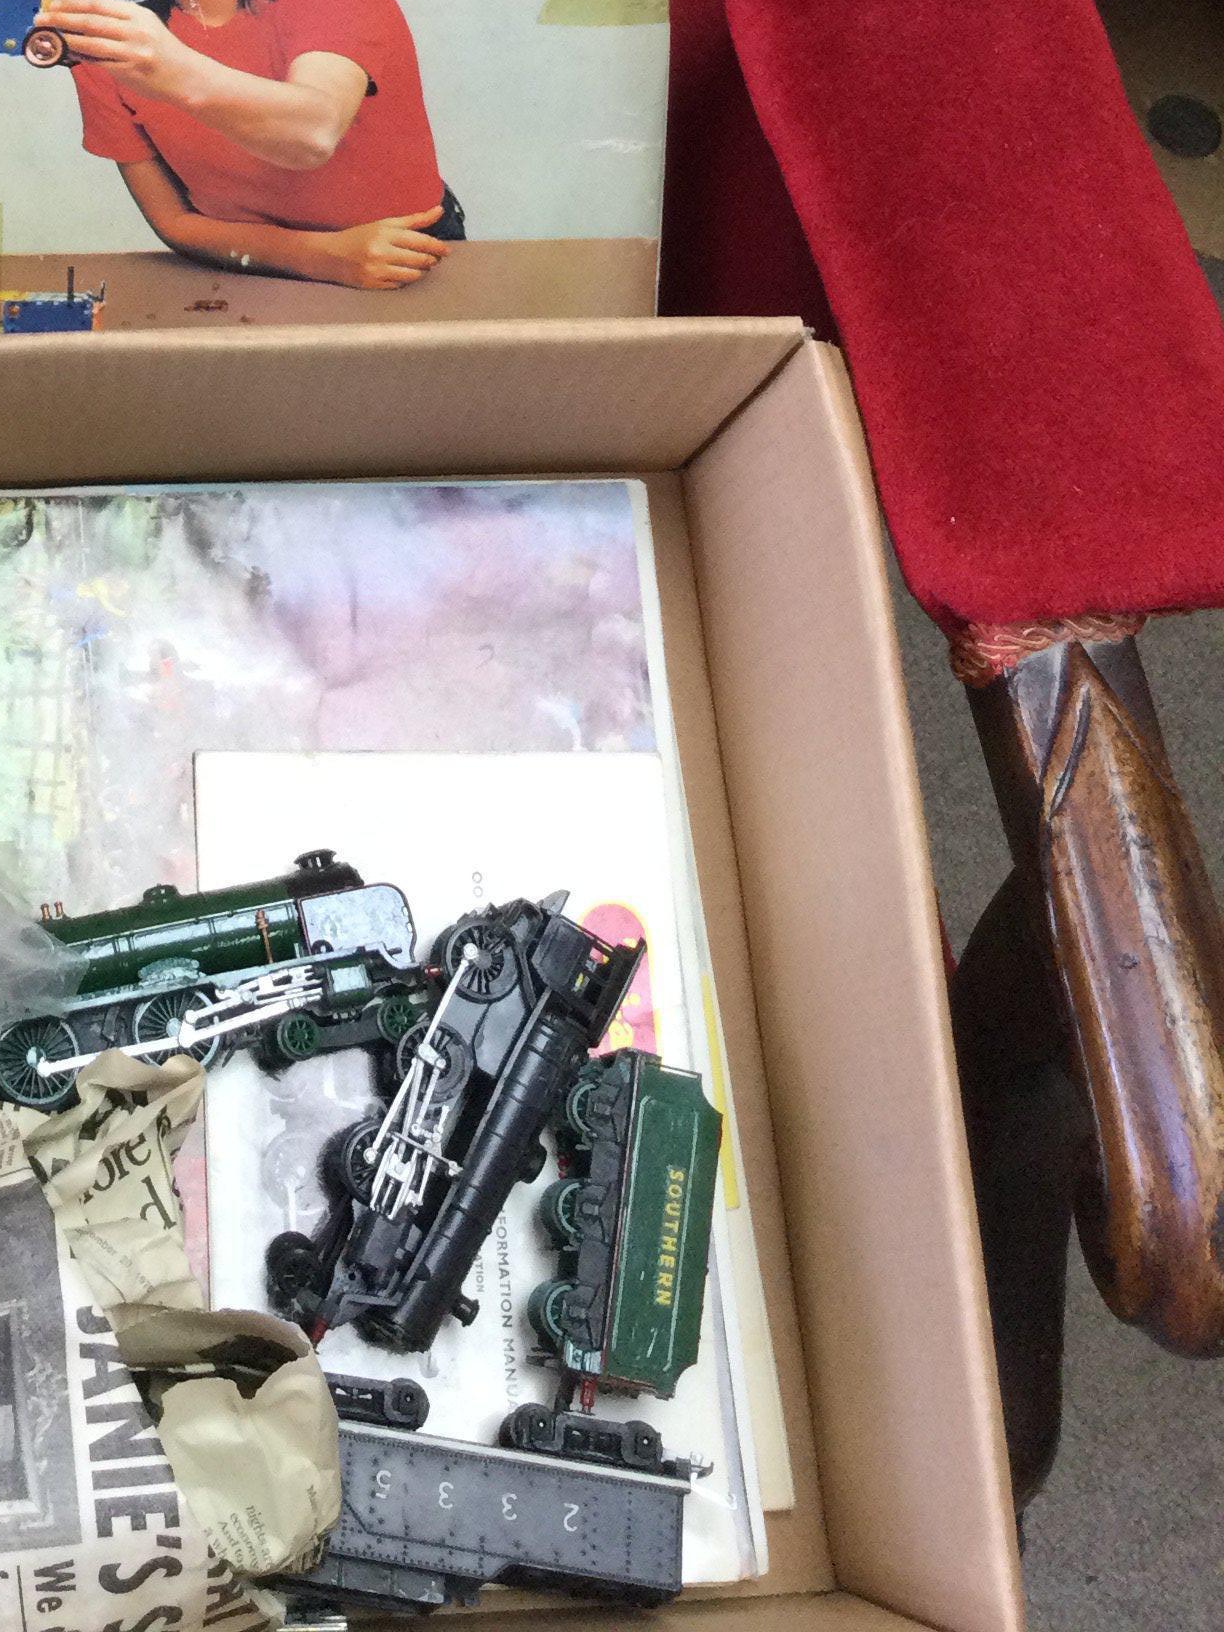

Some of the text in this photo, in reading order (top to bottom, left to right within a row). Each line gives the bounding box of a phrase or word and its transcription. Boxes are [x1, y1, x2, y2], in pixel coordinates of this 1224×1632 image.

[494, 1213, 520, 1415] FORMATION MANUA
[655, 1168, 685, 1308] SOUTHERN
[76, 1305, 184, 1595] JANIE'S
[32, 1558, 76, 1614] We
